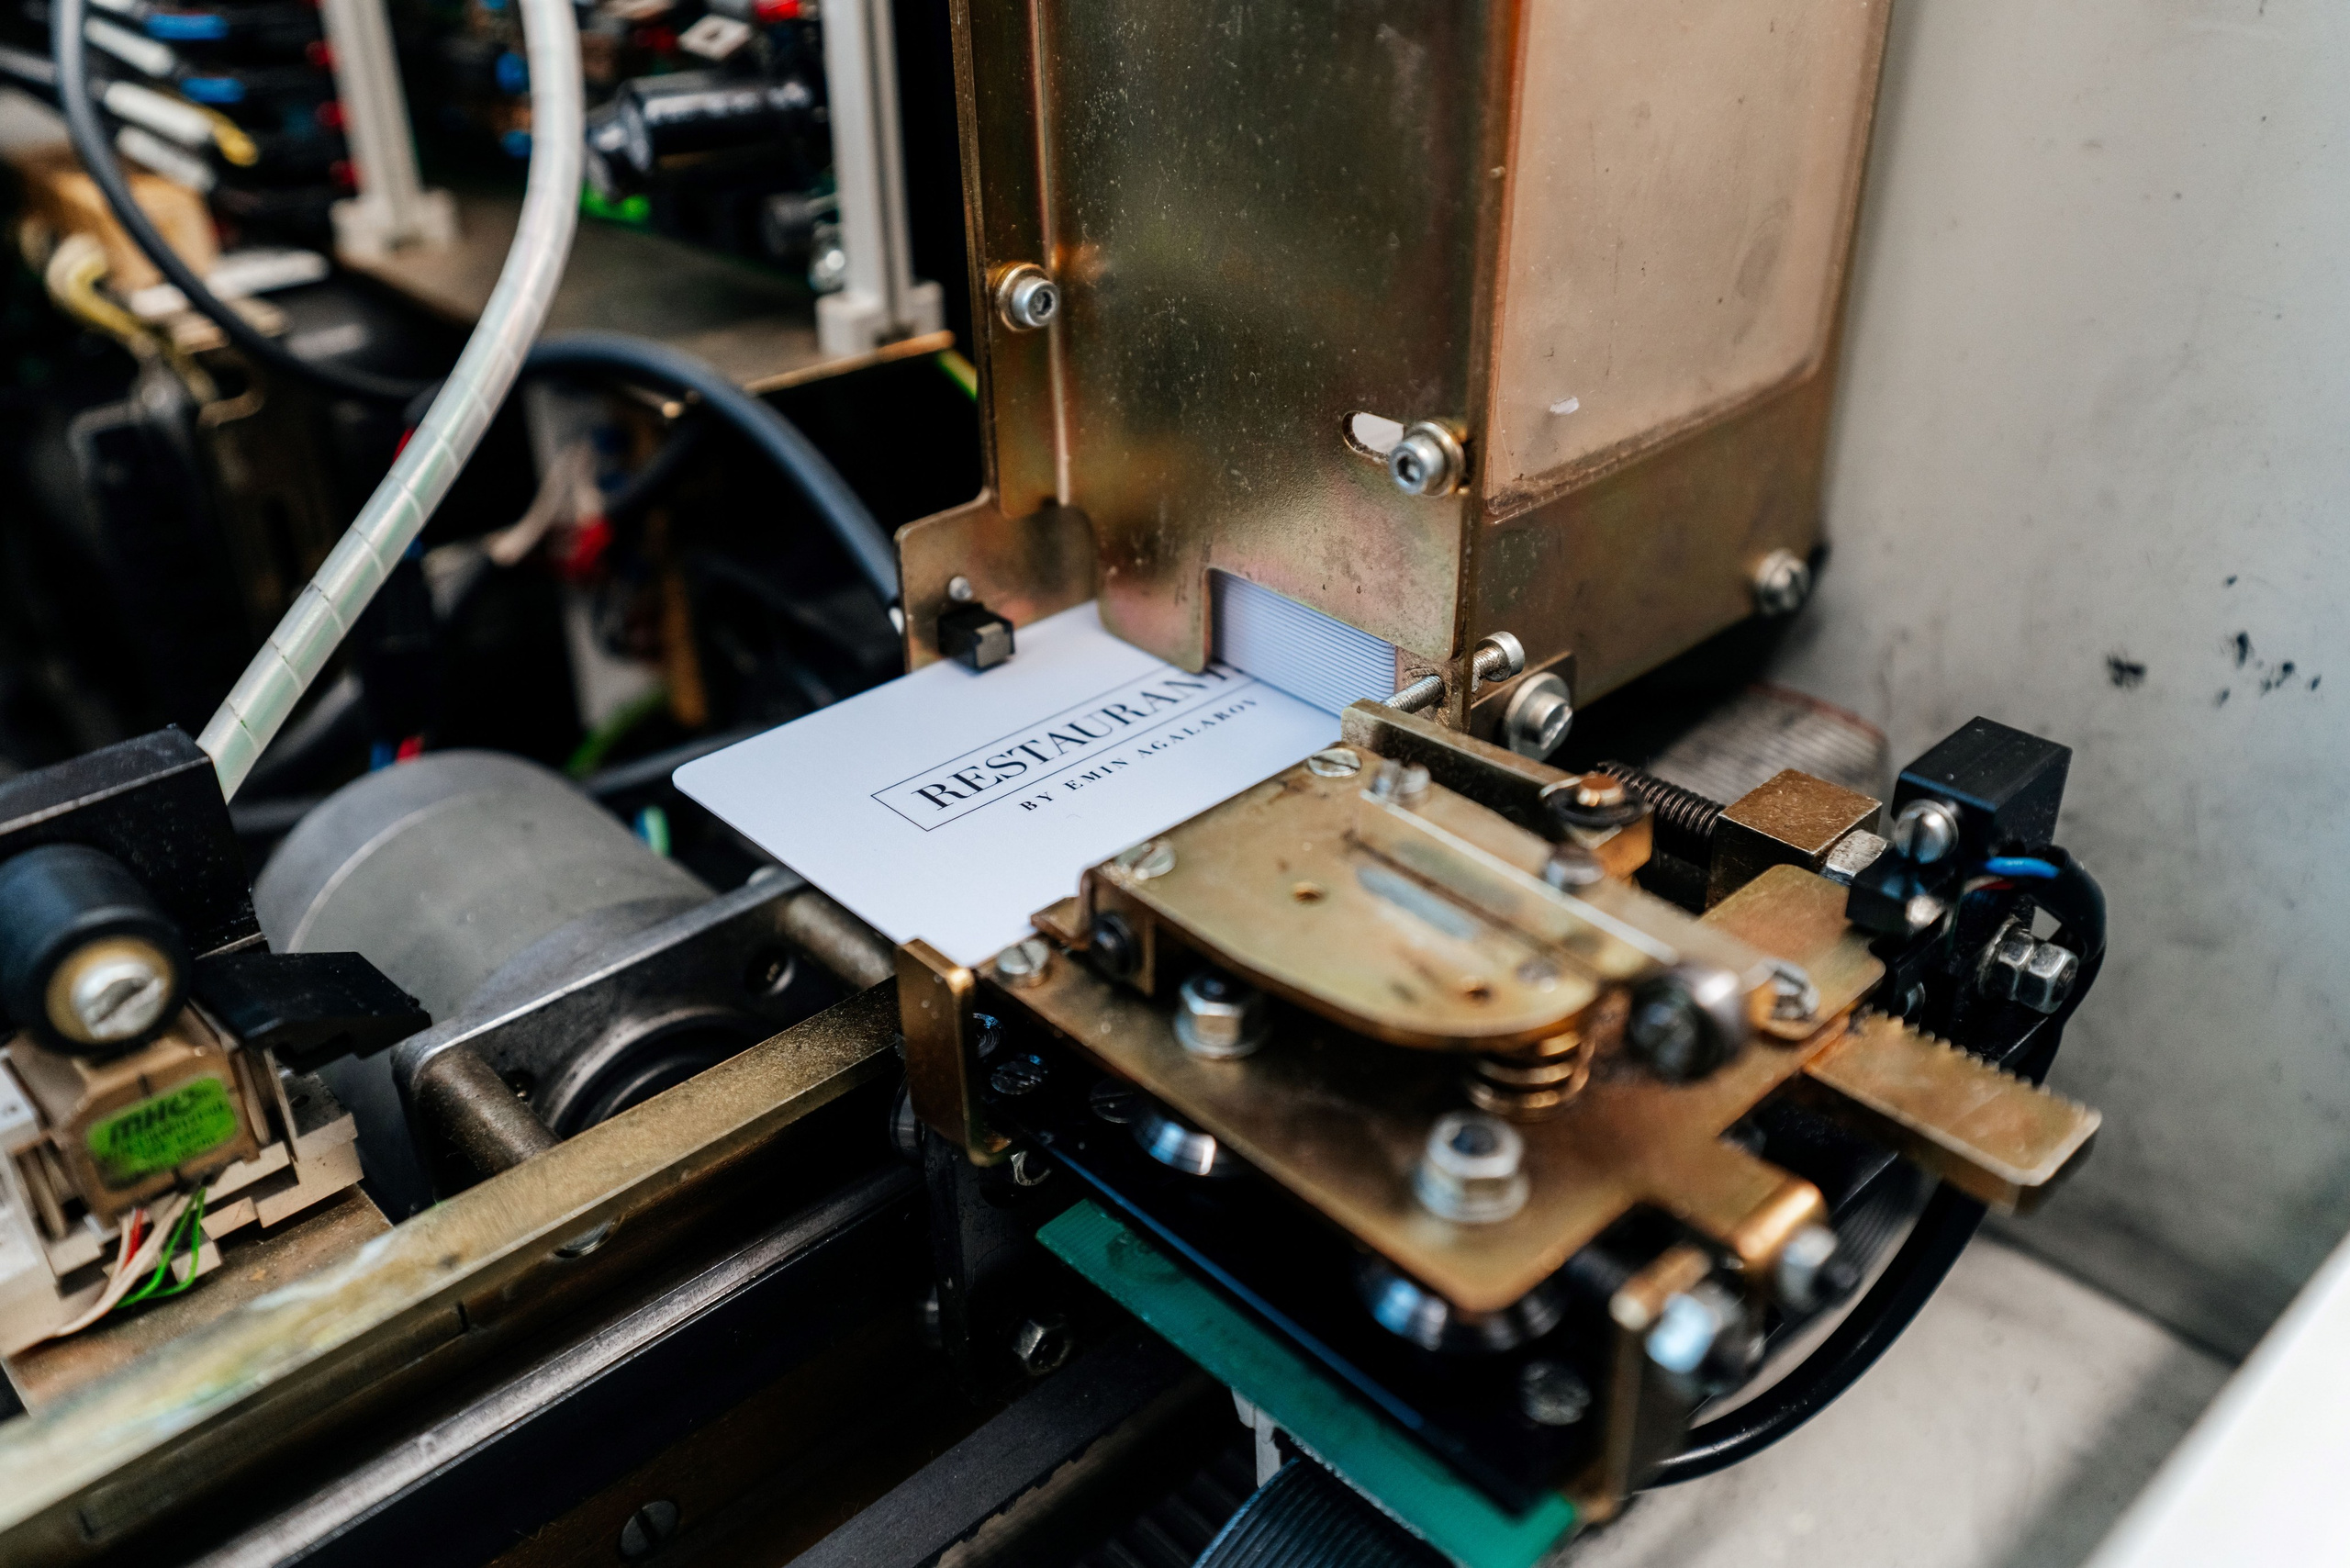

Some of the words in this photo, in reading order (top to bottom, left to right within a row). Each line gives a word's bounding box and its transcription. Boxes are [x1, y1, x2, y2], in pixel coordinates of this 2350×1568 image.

[912, 661, 1245, 810] RESTAURANT
[1019, 791, 1054, 811] BY
[1063, 757, 1129, 790] EMIN
